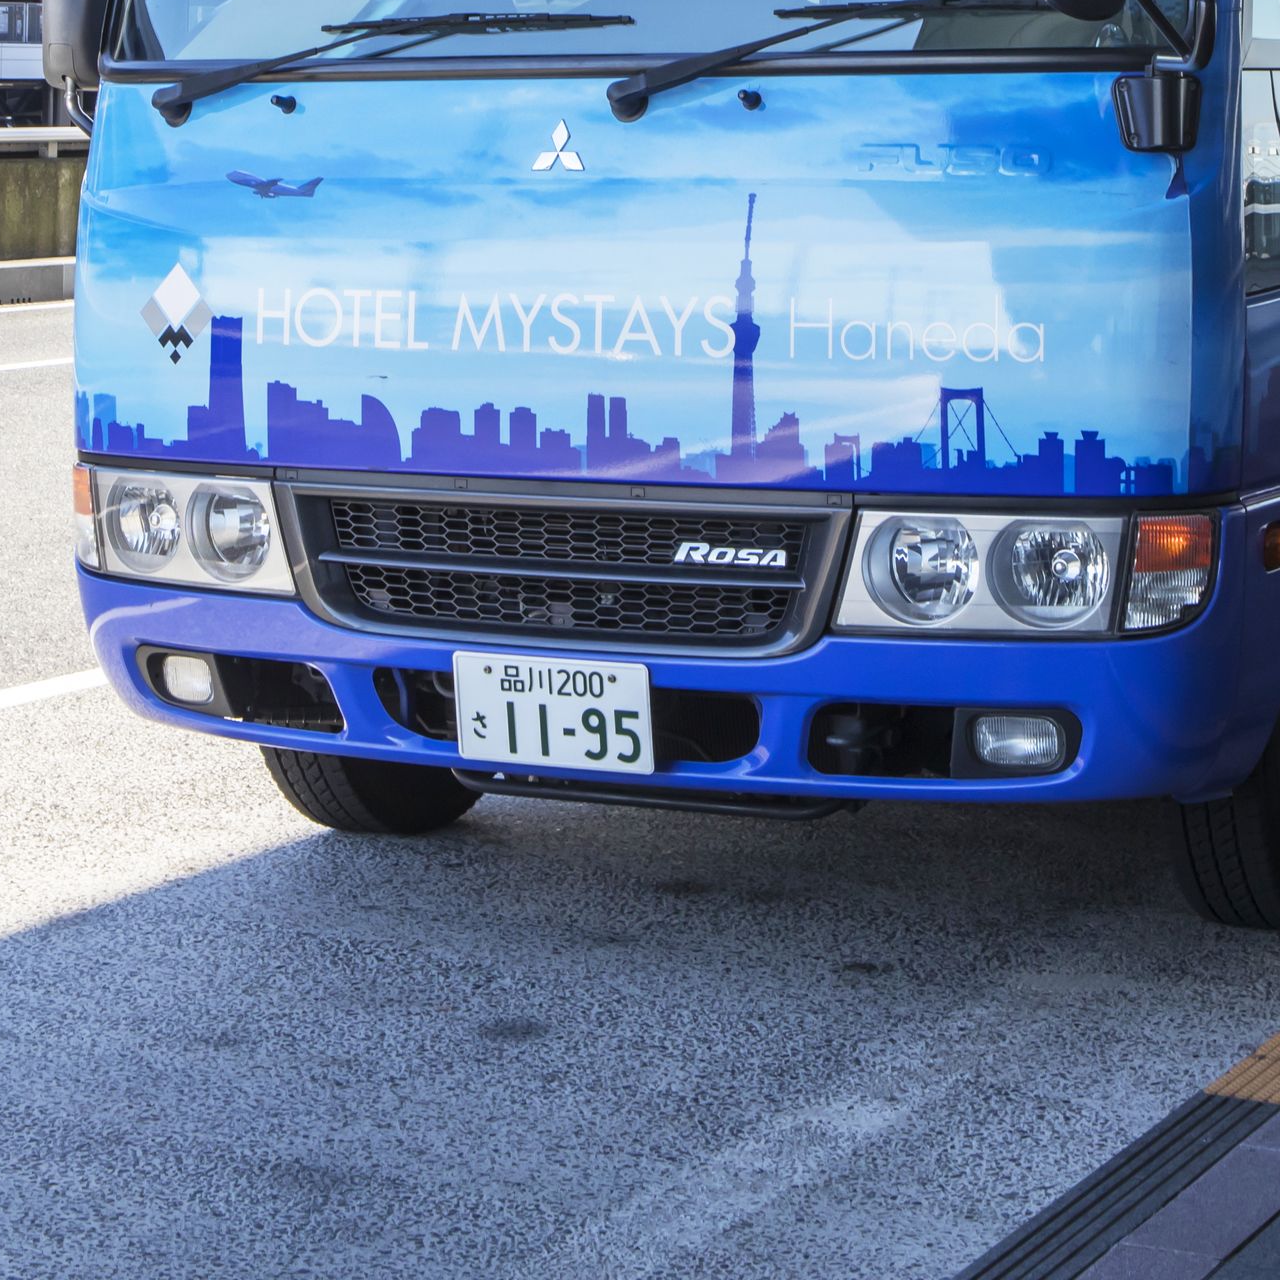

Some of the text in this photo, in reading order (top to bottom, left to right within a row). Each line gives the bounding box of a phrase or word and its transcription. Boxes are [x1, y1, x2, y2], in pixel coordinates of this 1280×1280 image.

[857, 142, 1054, 177] FUSO
[255, 287, 1045, 362] HOTEL MYSTAYS Haneda
[471, 700, 642, 763] さ 11-95
